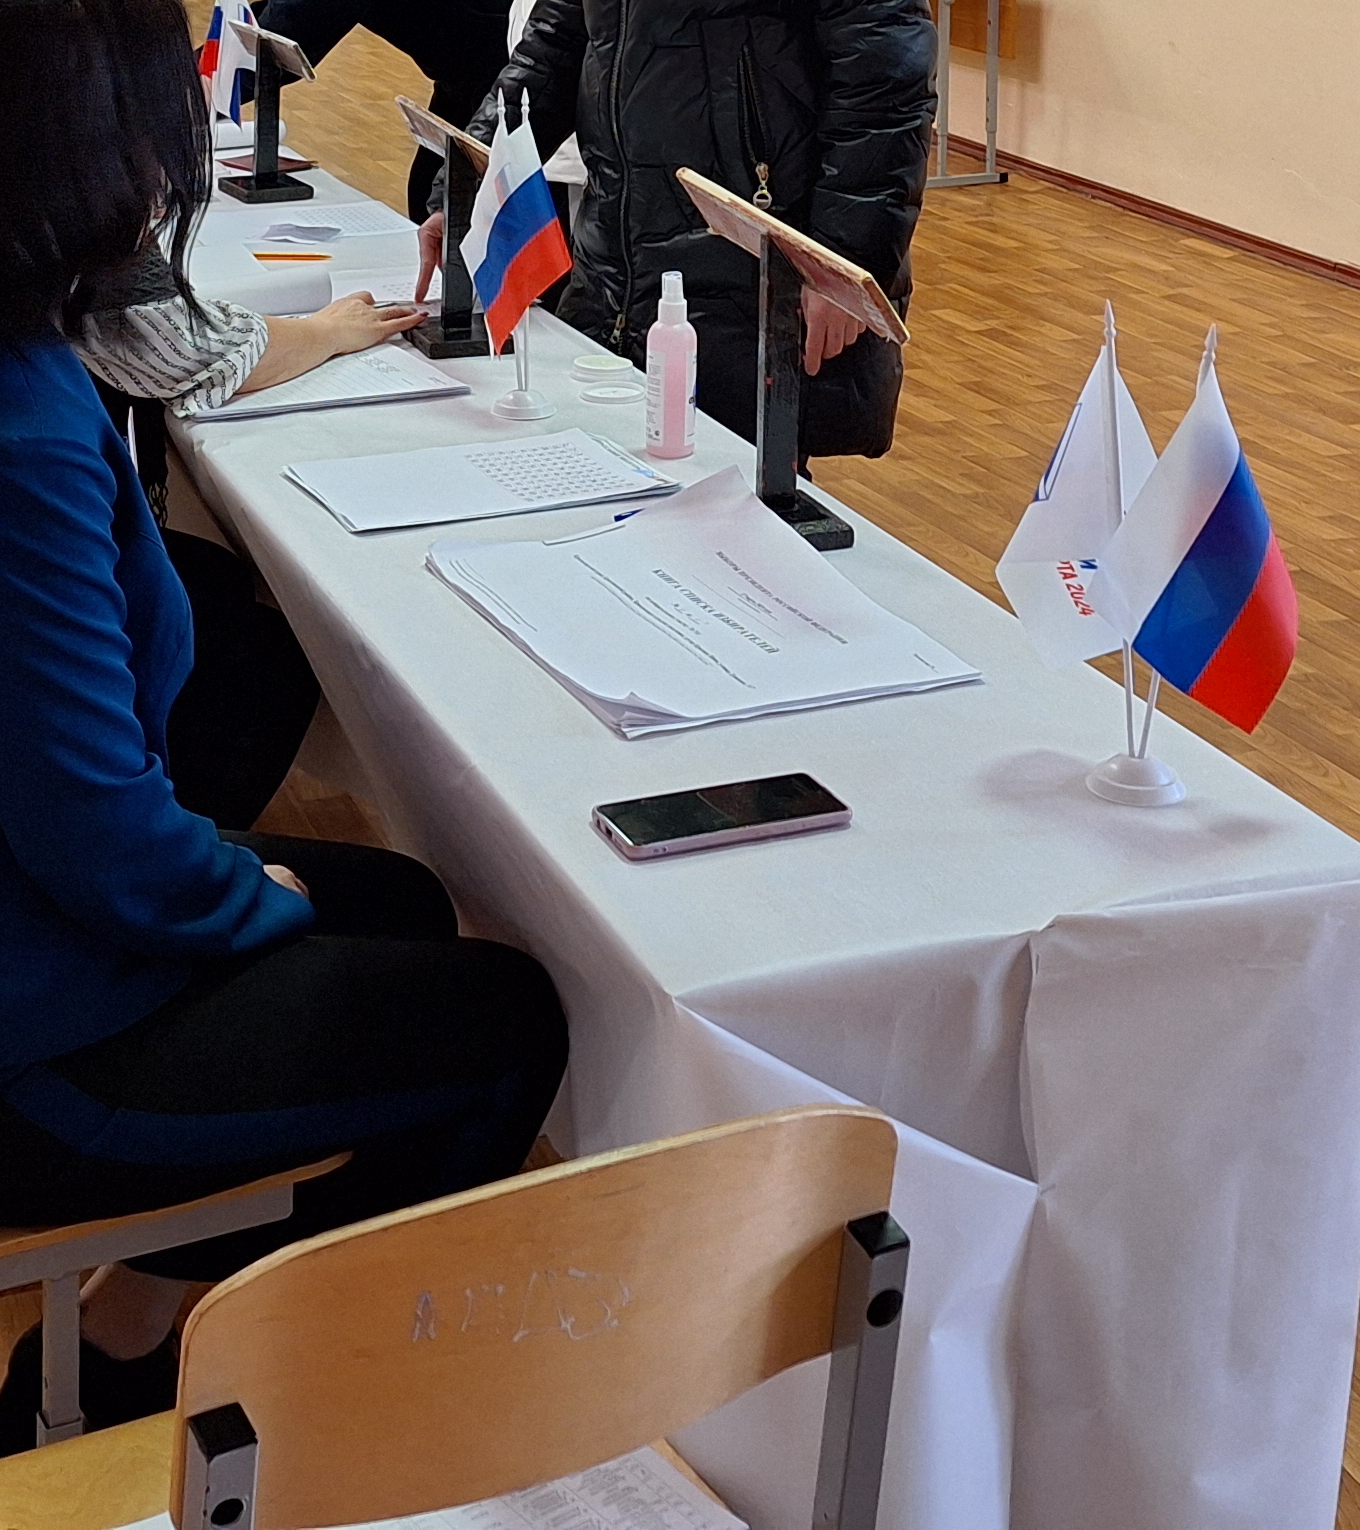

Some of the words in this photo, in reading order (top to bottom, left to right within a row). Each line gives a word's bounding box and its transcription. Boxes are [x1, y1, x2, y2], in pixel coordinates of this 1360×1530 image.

[652, 567, 681, 590] КНИГА
[679, 585, 715, 616] СПИСКА
[712, 609, 781, 655] ИЗБИРАТЕЛЕЙ
